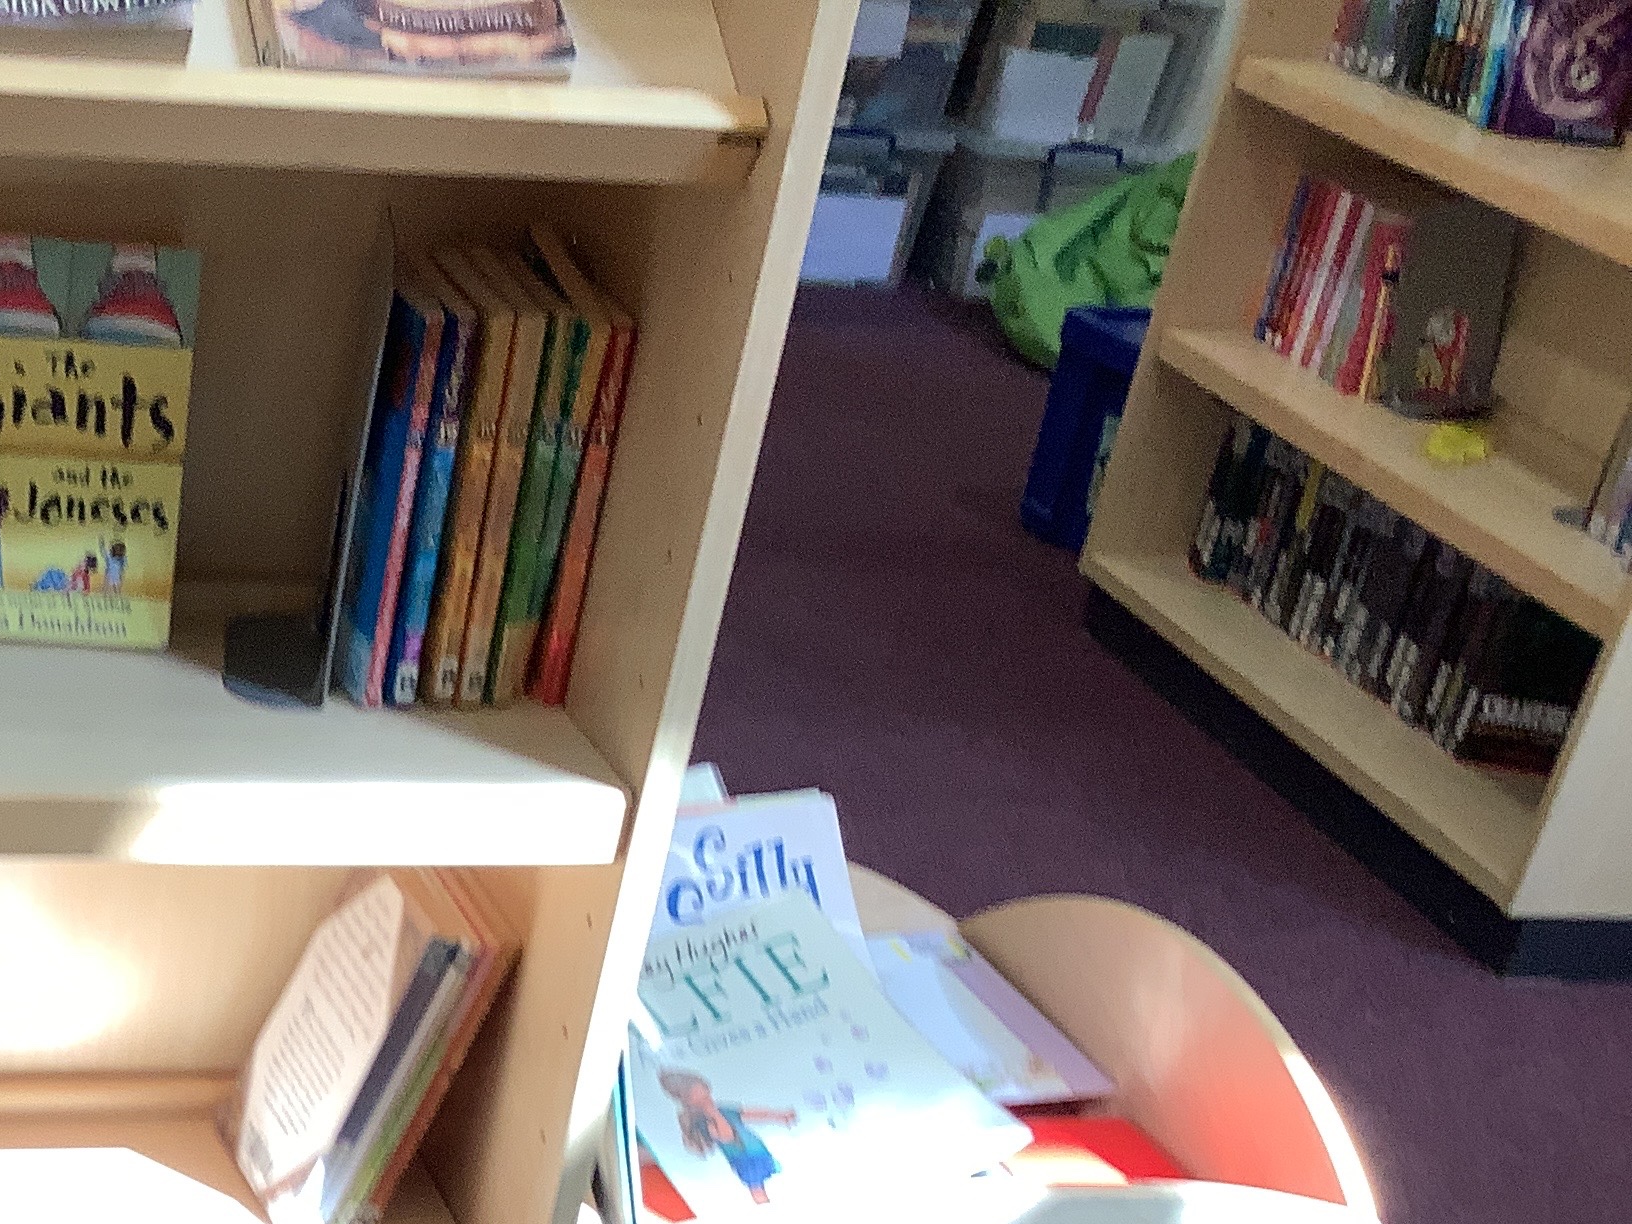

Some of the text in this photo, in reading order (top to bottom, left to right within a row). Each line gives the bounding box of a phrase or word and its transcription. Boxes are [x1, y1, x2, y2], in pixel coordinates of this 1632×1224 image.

[45, 349, 96, 380] The
[692, 824, 823, 911] Silly
[638, 931, 831, 1036] LFIE
